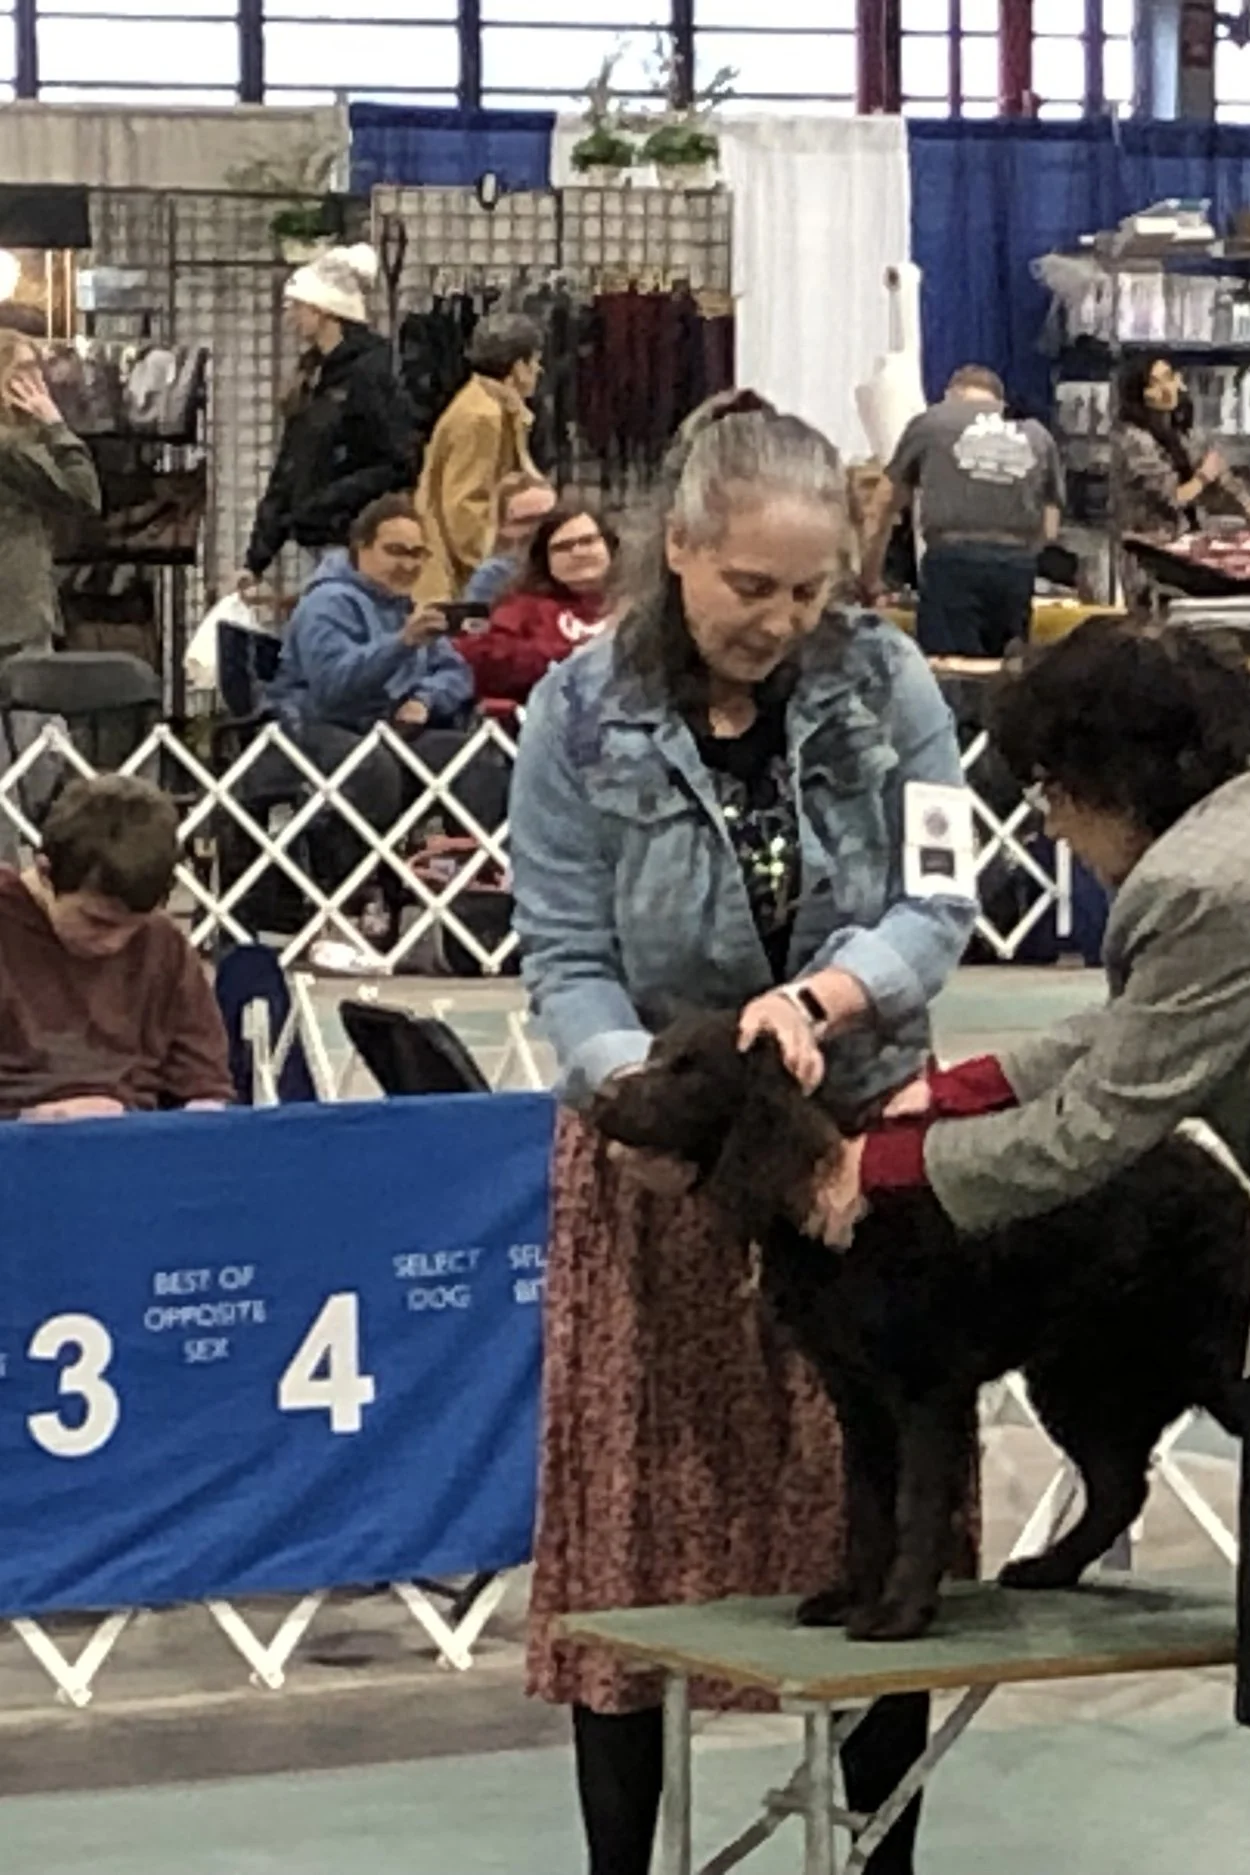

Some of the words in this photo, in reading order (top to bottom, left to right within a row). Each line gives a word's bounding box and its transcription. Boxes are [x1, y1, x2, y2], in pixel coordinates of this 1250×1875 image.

[393, 1247, 485, 1278] SELECT
[508, 1243, 548, 1270] SEL
[154, 1268, 210, 1295] BEST
[218, 1264, 255, 1290] OF
[407, 1284, 471, 1311] DOG
[144, 1299, 267, 1332] OPPOSITE
[183, 1337, 230, 1364] SEX
[277, 1291, 375, 1434] 4
[27, 1312, 120, 1457] 3
